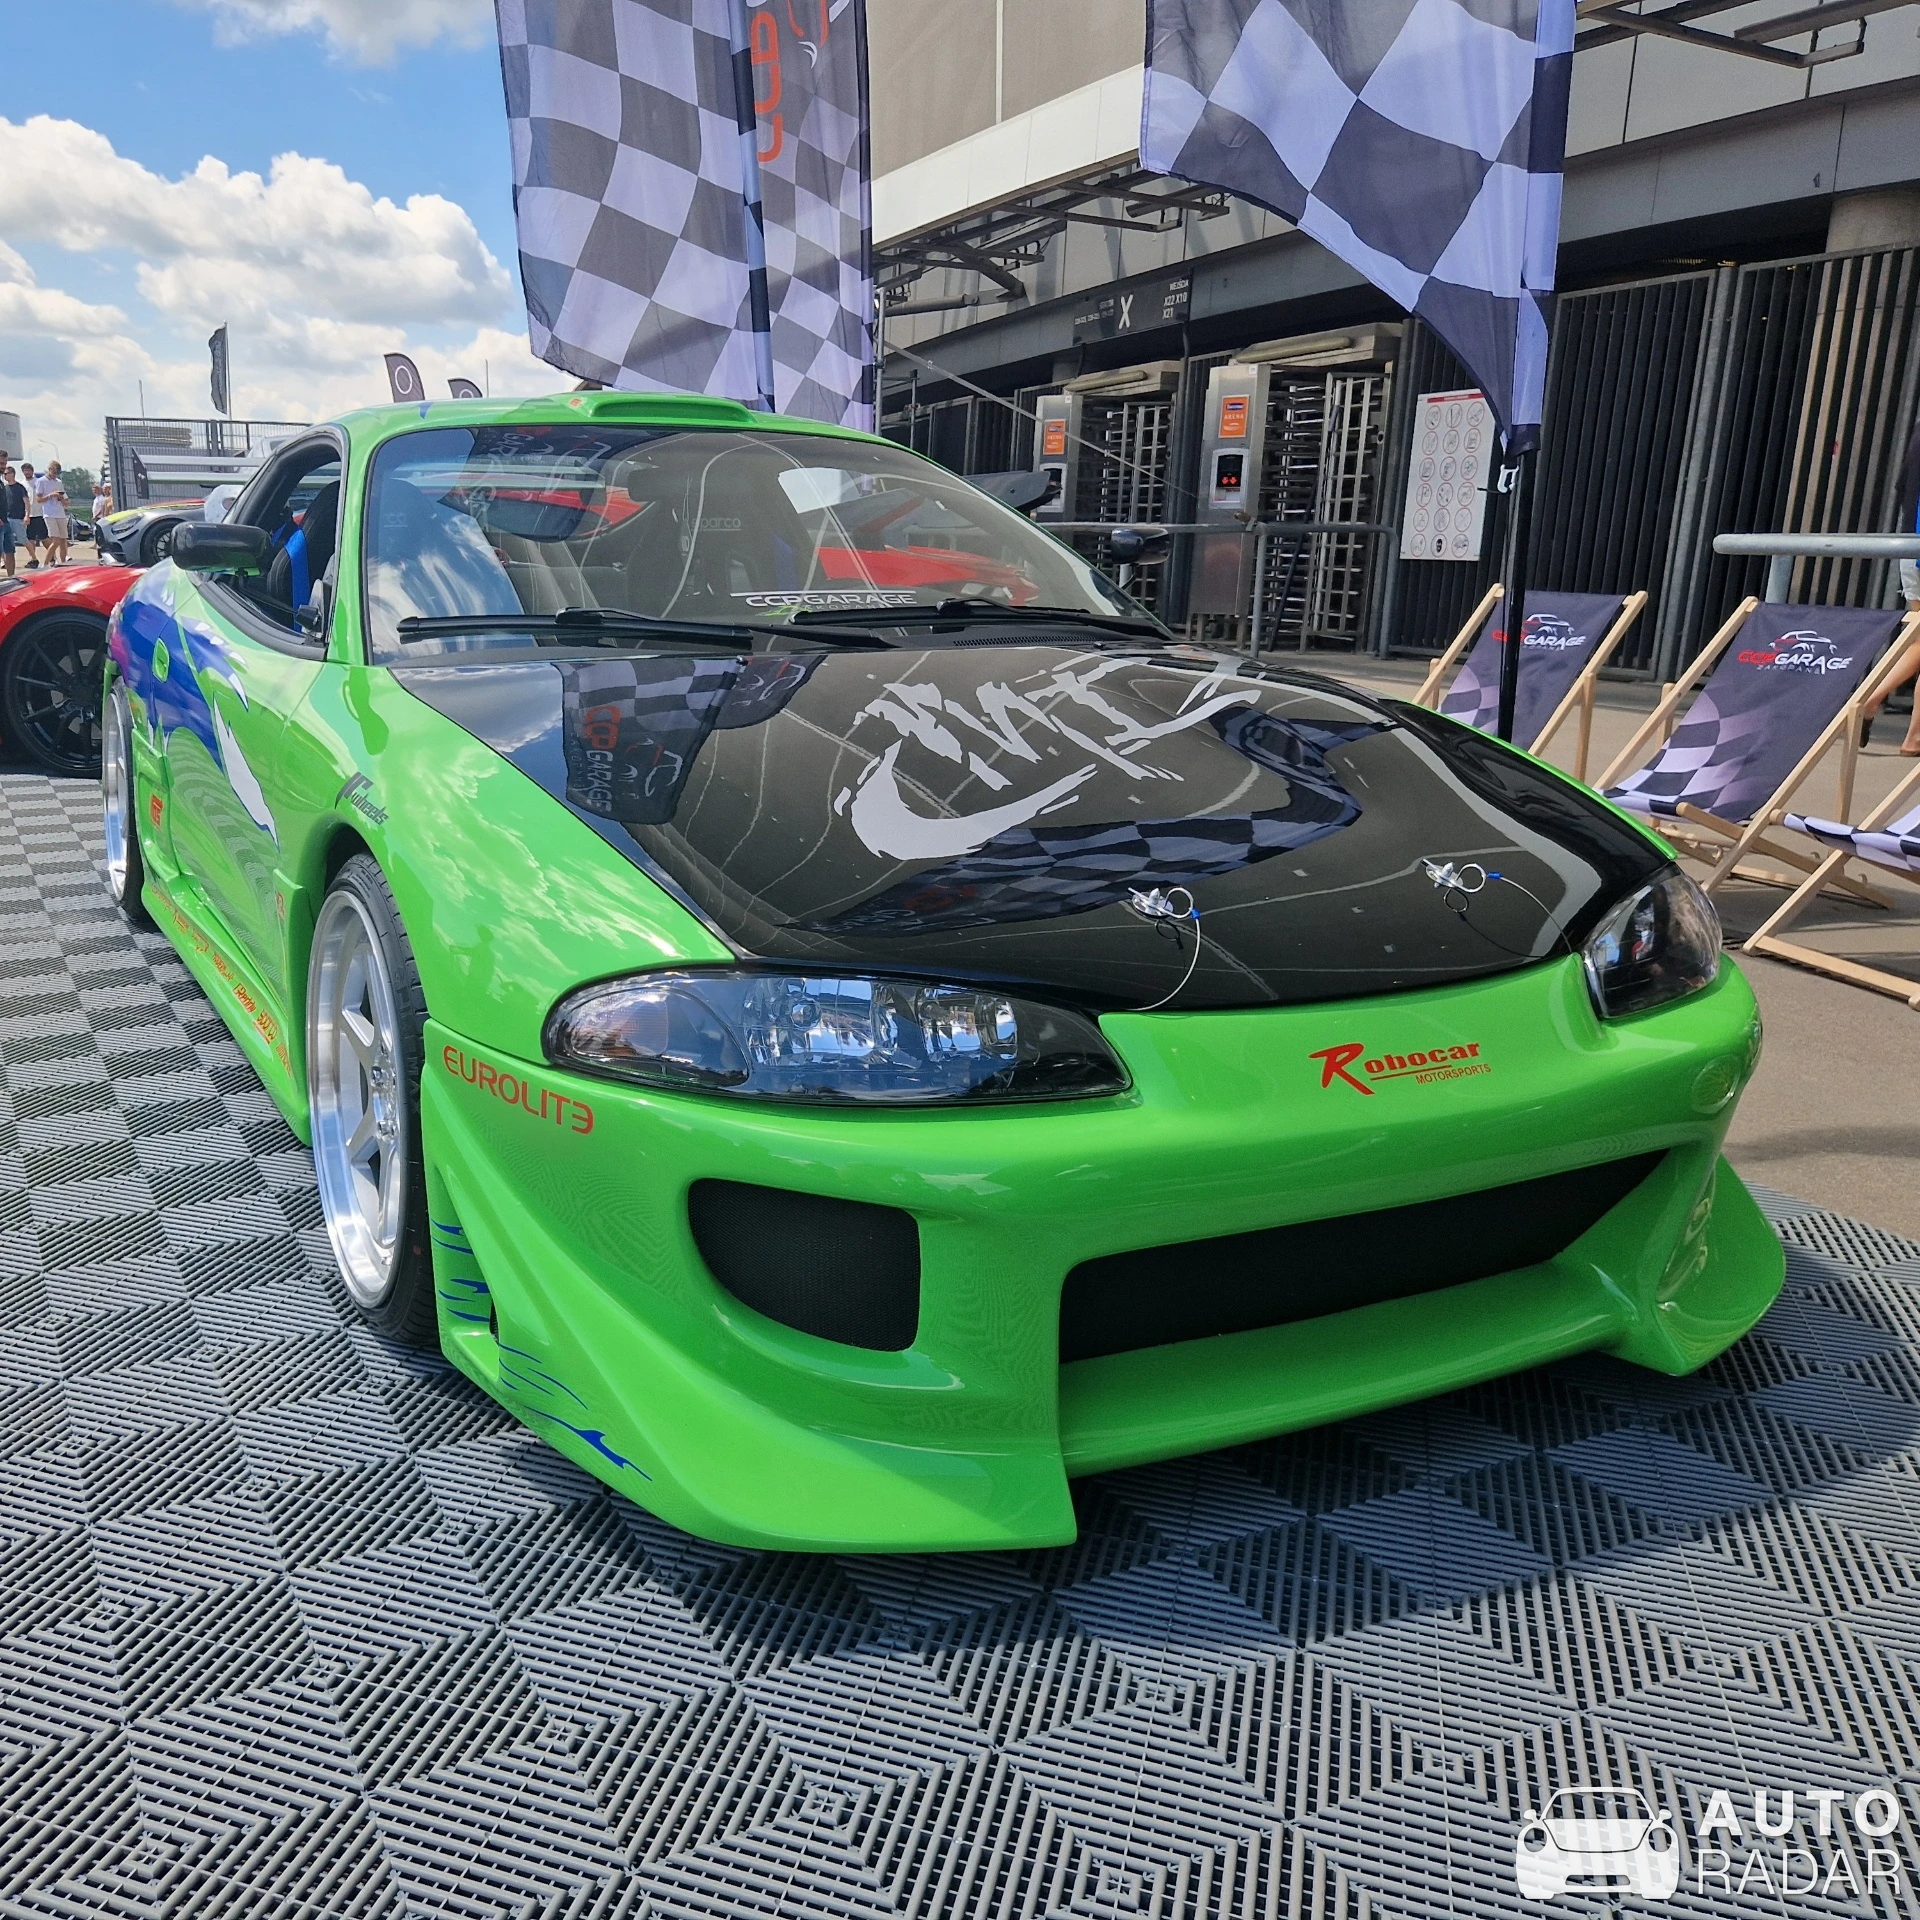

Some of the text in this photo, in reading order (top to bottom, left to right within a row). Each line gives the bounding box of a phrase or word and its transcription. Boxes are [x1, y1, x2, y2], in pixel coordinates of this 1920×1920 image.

[1119, 294, 1134, 330] X
[1308, 1042, 1481, 1095] Robocar
[1416, 1063, 1491, 1085] MOTORSPORTS
